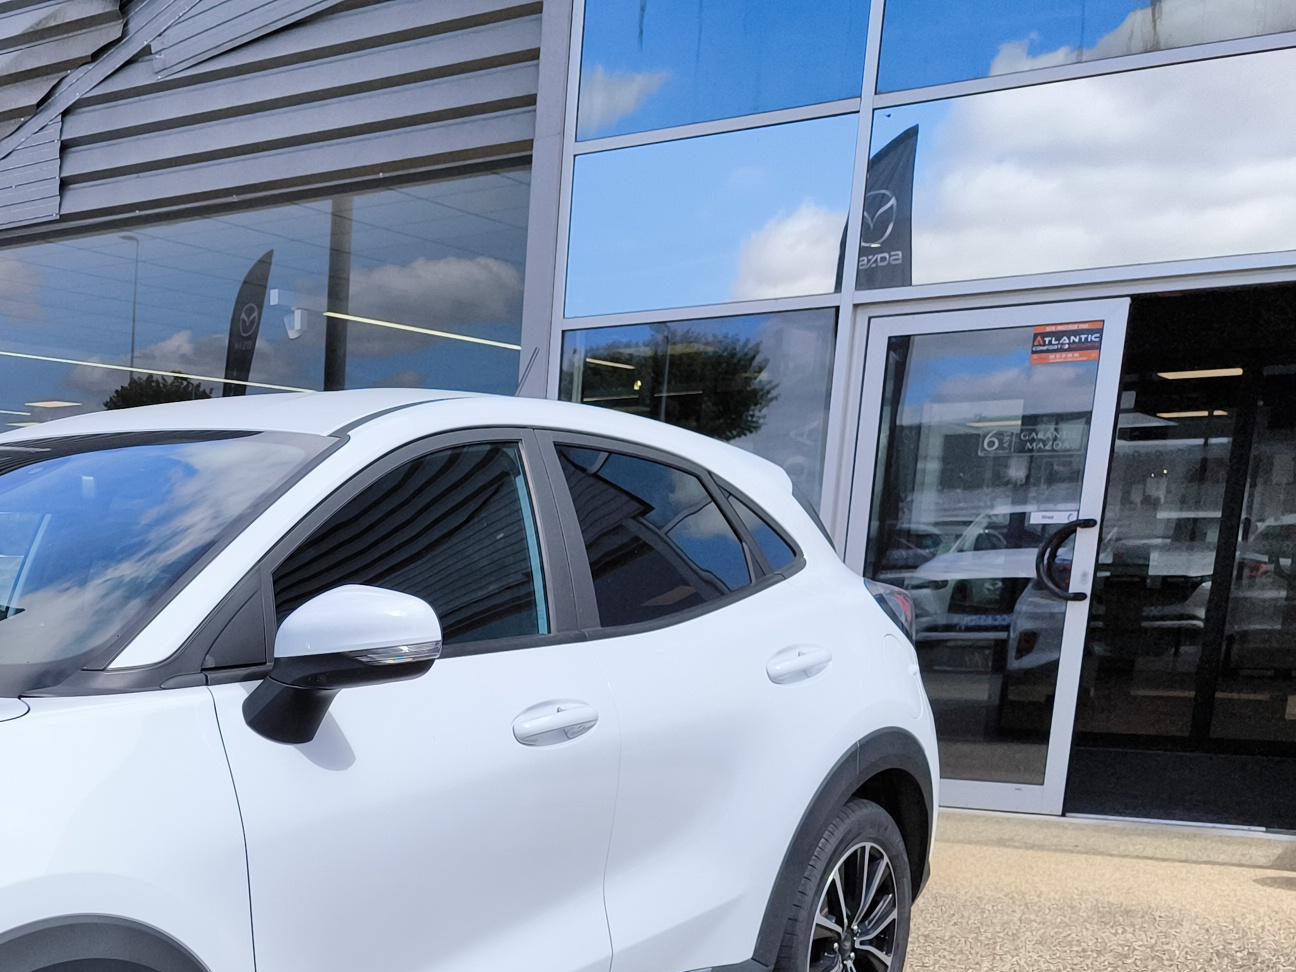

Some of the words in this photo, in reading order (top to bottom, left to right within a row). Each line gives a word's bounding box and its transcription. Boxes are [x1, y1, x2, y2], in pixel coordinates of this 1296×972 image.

[859, 251, 902, 269] azda
[1034, 334, 1101, 346] ATLANTIC
[984, 430, 999, 451] 6
[1020, 430, 1076, 441] GARAN
